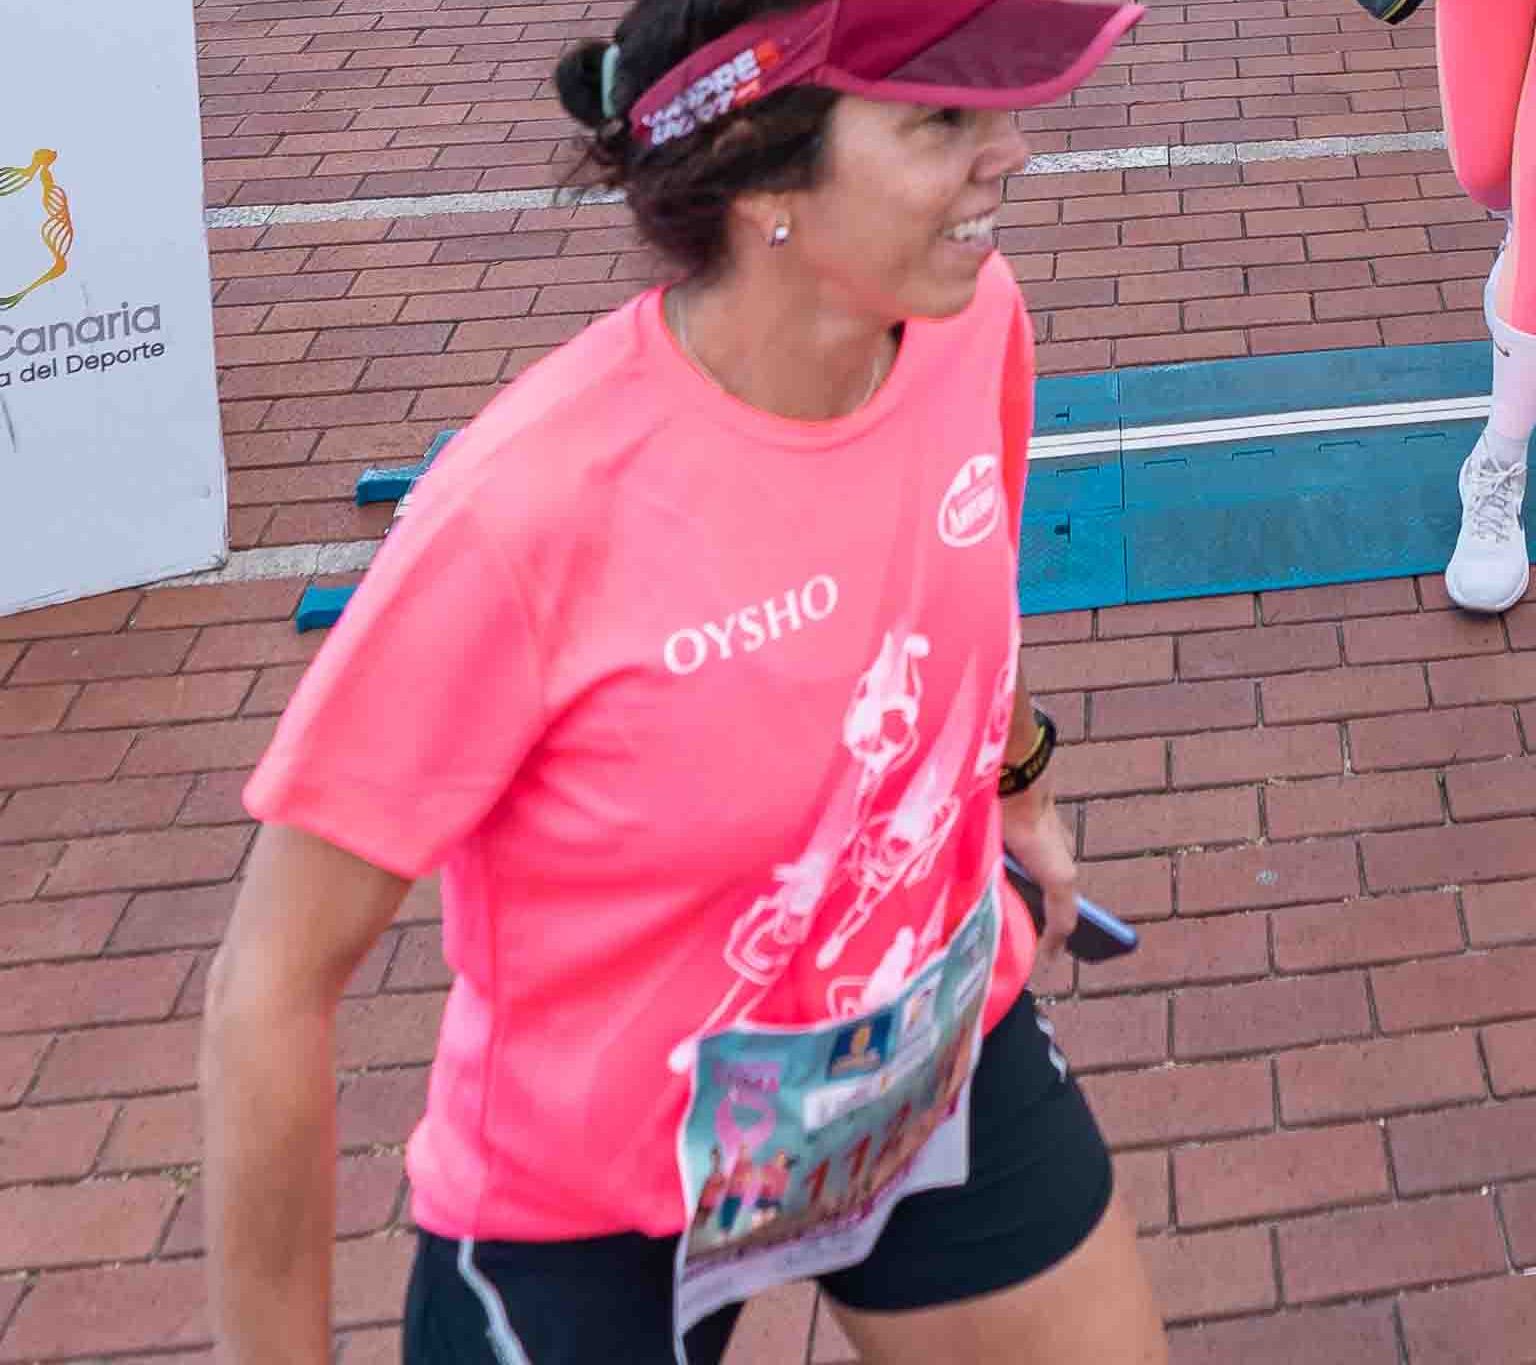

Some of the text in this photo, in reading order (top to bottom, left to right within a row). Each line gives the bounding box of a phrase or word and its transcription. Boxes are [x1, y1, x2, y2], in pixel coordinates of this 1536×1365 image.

[20, 357, 58, 384] del
[66, 338, 166, 379] Deporte
[662, 572, 840, 675] OYSHO
